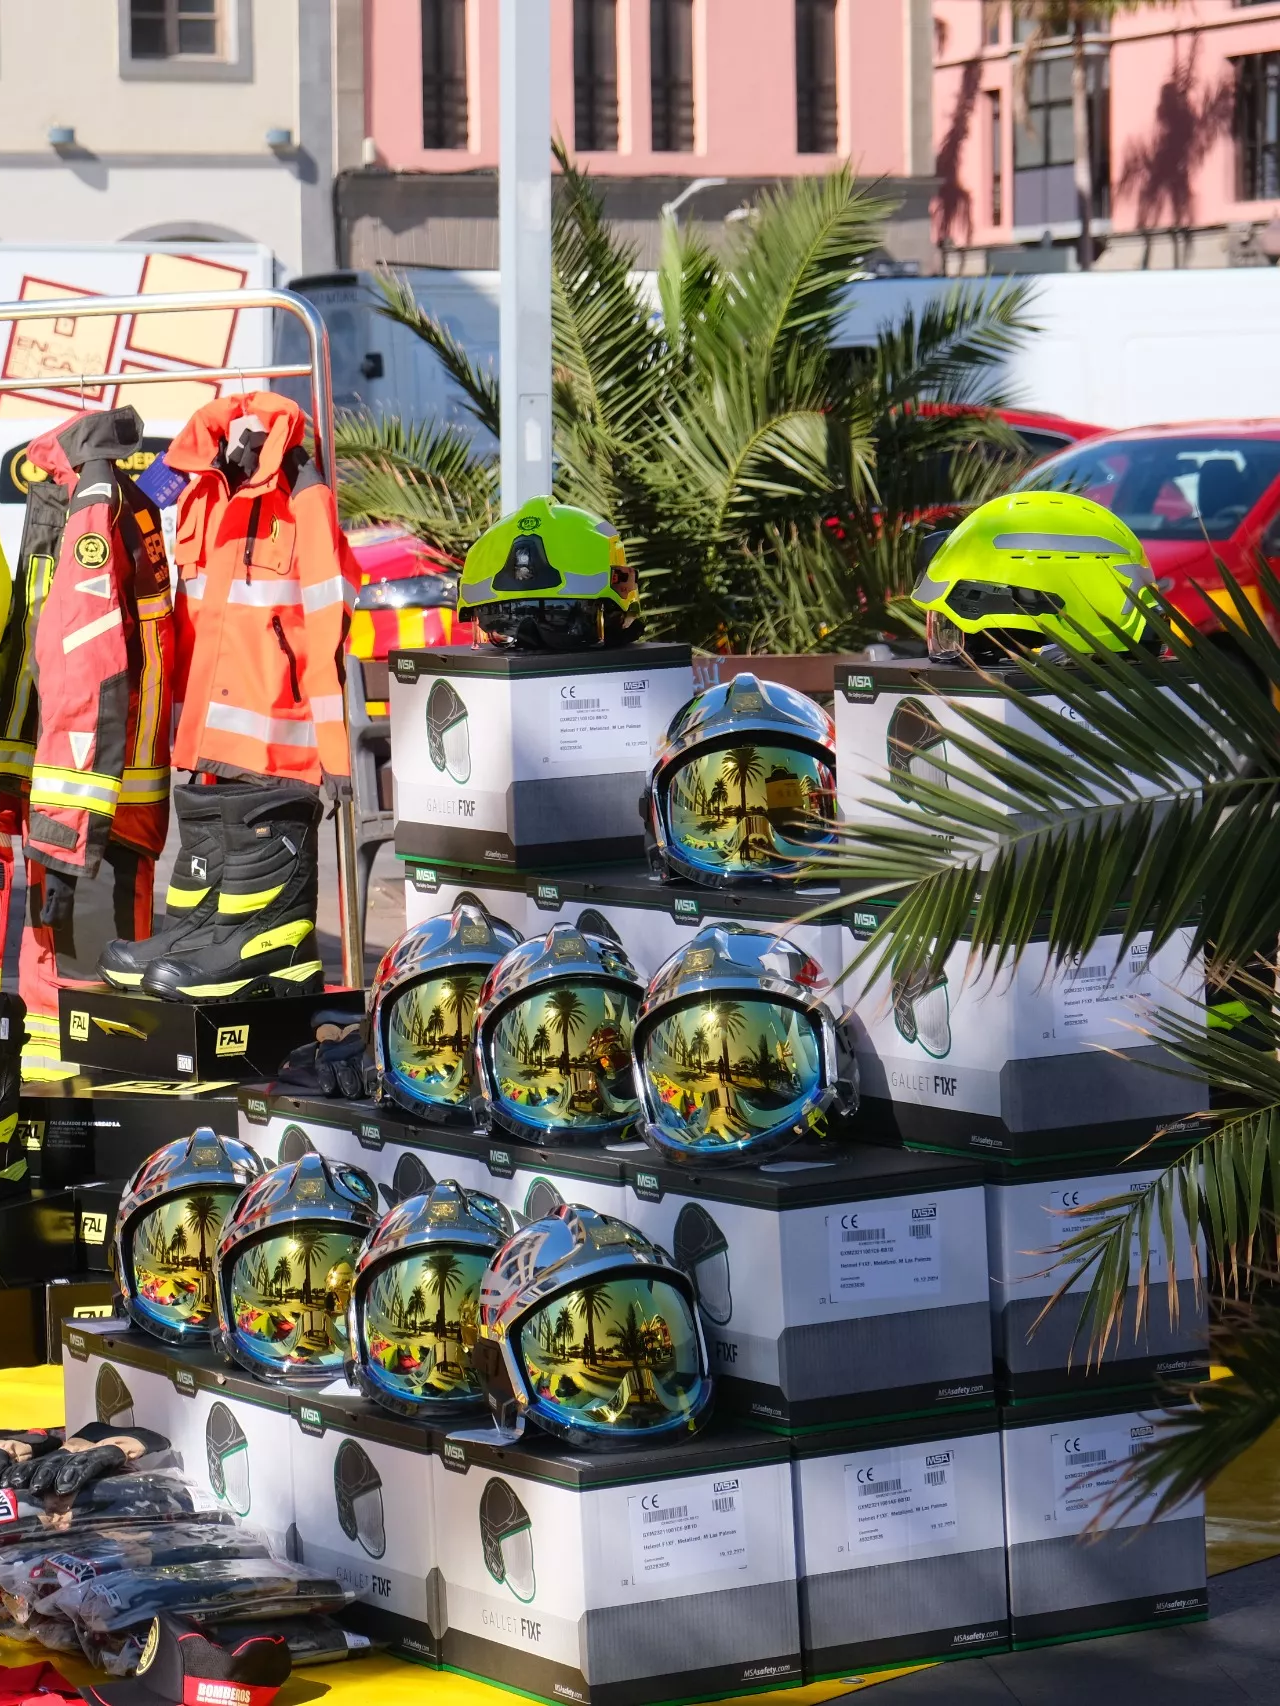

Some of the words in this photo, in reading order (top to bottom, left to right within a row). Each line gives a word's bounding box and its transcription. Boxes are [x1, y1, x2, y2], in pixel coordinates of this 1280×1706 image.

[398, 659, 415, 671] MSA
[624, 682, 645, 690] MSA
[848, 675, 872, 688] MSA
[426, 797, 456, 814] GALLET
[458, 800, 476, 816] F1XF
[416, 869, 436, 882] MSA
[538, 886, 558, 899] MSA
[674, 899, 697, 912] MSA
[854, 912, 877, 927] MSA
[72, 1015, 87, 1031] FAL
[219, 1029, 245, 1046] FAL
[891, 1072, 930, 1092] GALLET
[934, 1075, 957, 1096] F1XF
[248, 1098, 267, 1113] MSA
[362, 1125, 380, 1139] MSA
[489, 1150, 510, 1164] MSA
[637, 1174, 659, 1189] MSA
[912, 1208, 936, 1218] MSA
[83, 1217, 102, 1232] FAL
[938, 1384, 984, 1396] MSAsafety.com
[301, 1406, 321, 1423] MSA
[444, 1443, 465, 1461] MSA
[926, 1453, 950, 1466] MSA
[714, 1480, 738, 1492] MSA
[372, 1575, 392, 1598] F1XF
[1155, 1598, 1199, 1611] MSAsafety.com
[482, 1609, 517, 1635] GALLET
[520, 1617, 542, 1643] F1XF
[953, 1629, 999, 1643] MSAsafety.com
[743, 1664, 791, 1678] MSAsafety.com
[197, 1682, 251, 1704] BOMBEROS
[554, 1683, 583, 1699] MSAsafety.com
